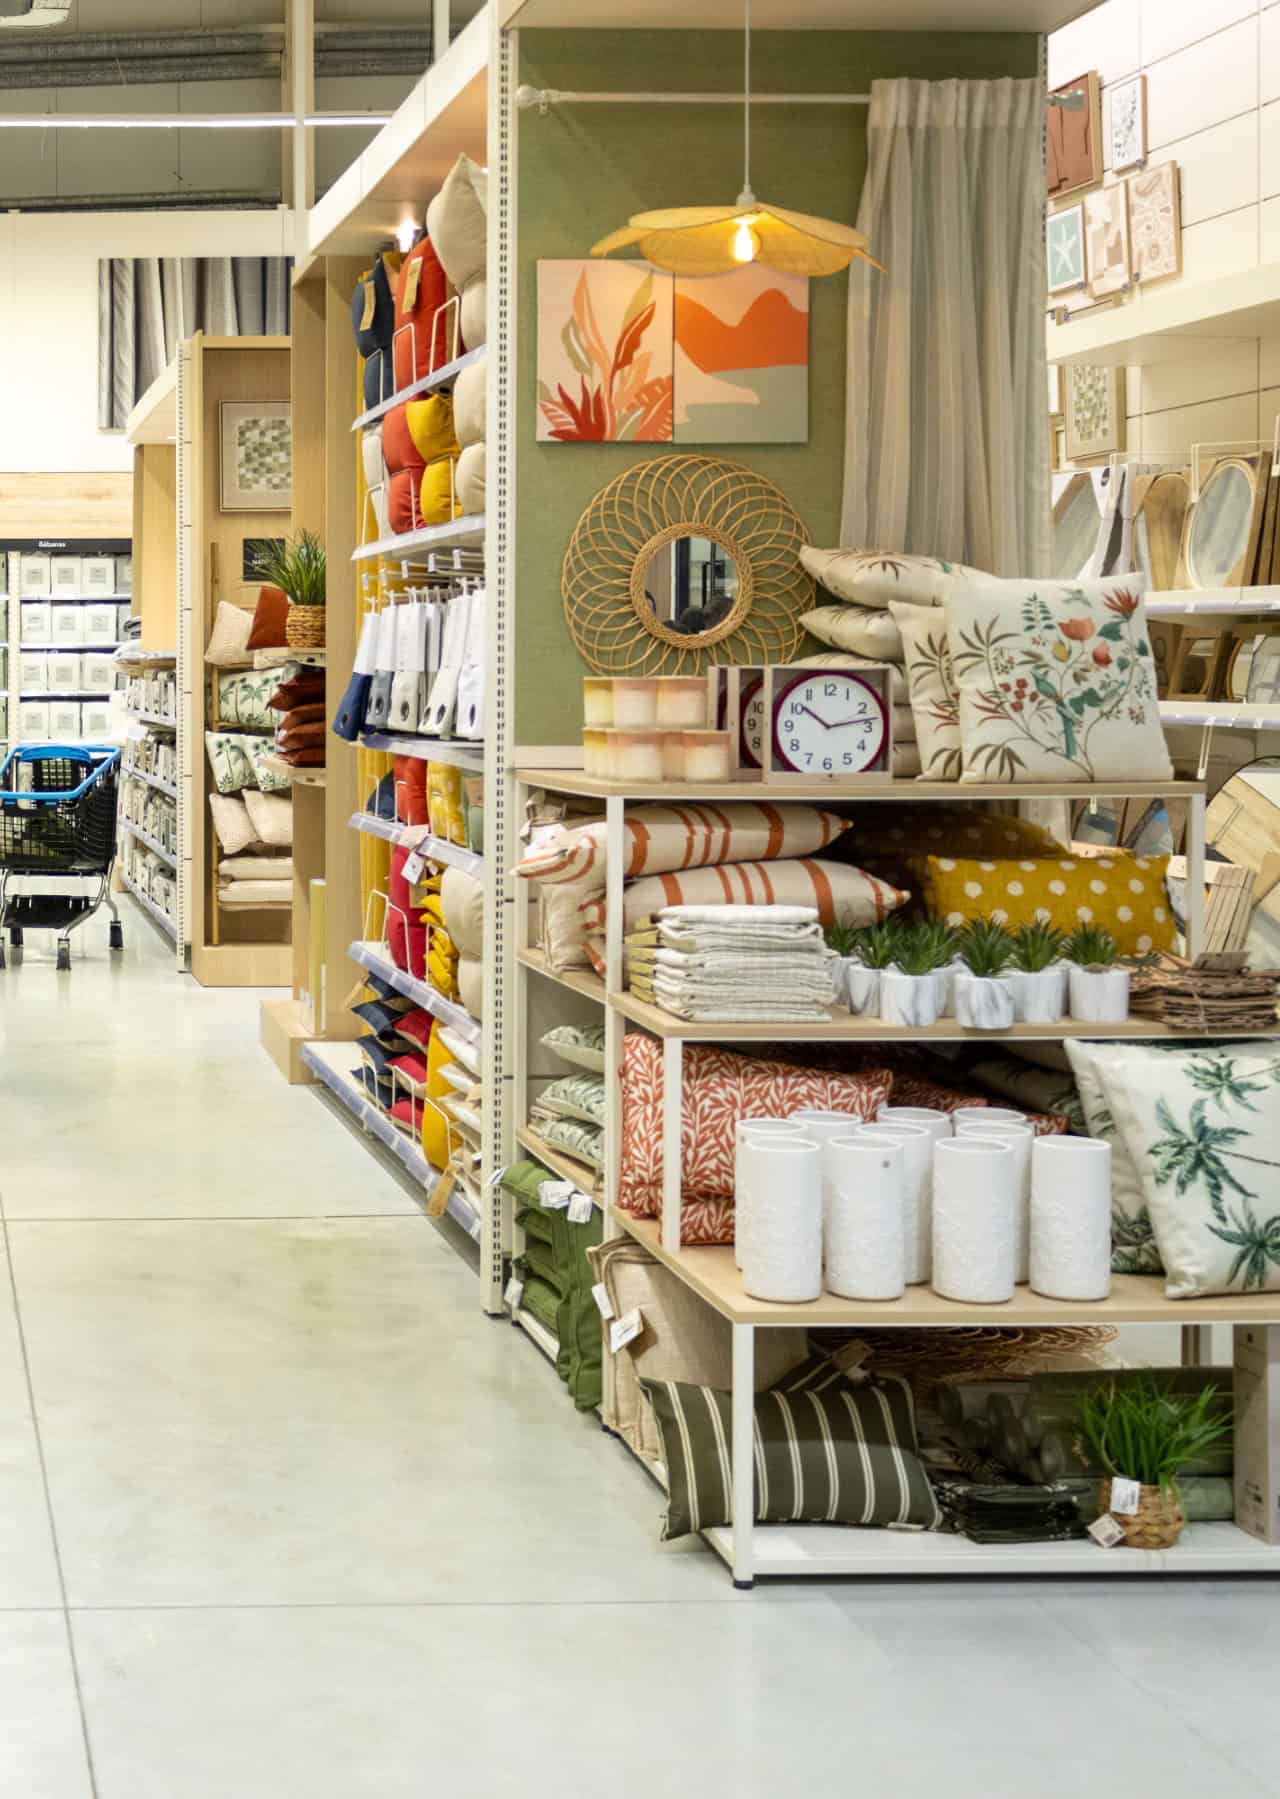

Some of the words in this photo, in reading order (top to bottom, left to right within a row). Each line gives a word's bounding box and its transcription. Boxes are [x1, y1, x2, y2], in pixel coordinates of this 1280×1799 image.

[806, 688, 813, 701] 11
[824, 683, 837, 696] 12
[791, 703, 804, 715] 10
[858, 702, 867, 714] 2
[747, 718, 756, 730] 9
[785, 720, 794, 732] 9
[864, 720, 873, 733] 3
[752, 737, 760, 749] 8
[790, 739, 800, 751] 8
[857, 739, 866, 752] 4
[804, 753, 813, 765] 7
[823, 758, 832, 770] 6
[843, 753, 852, 765] 5
